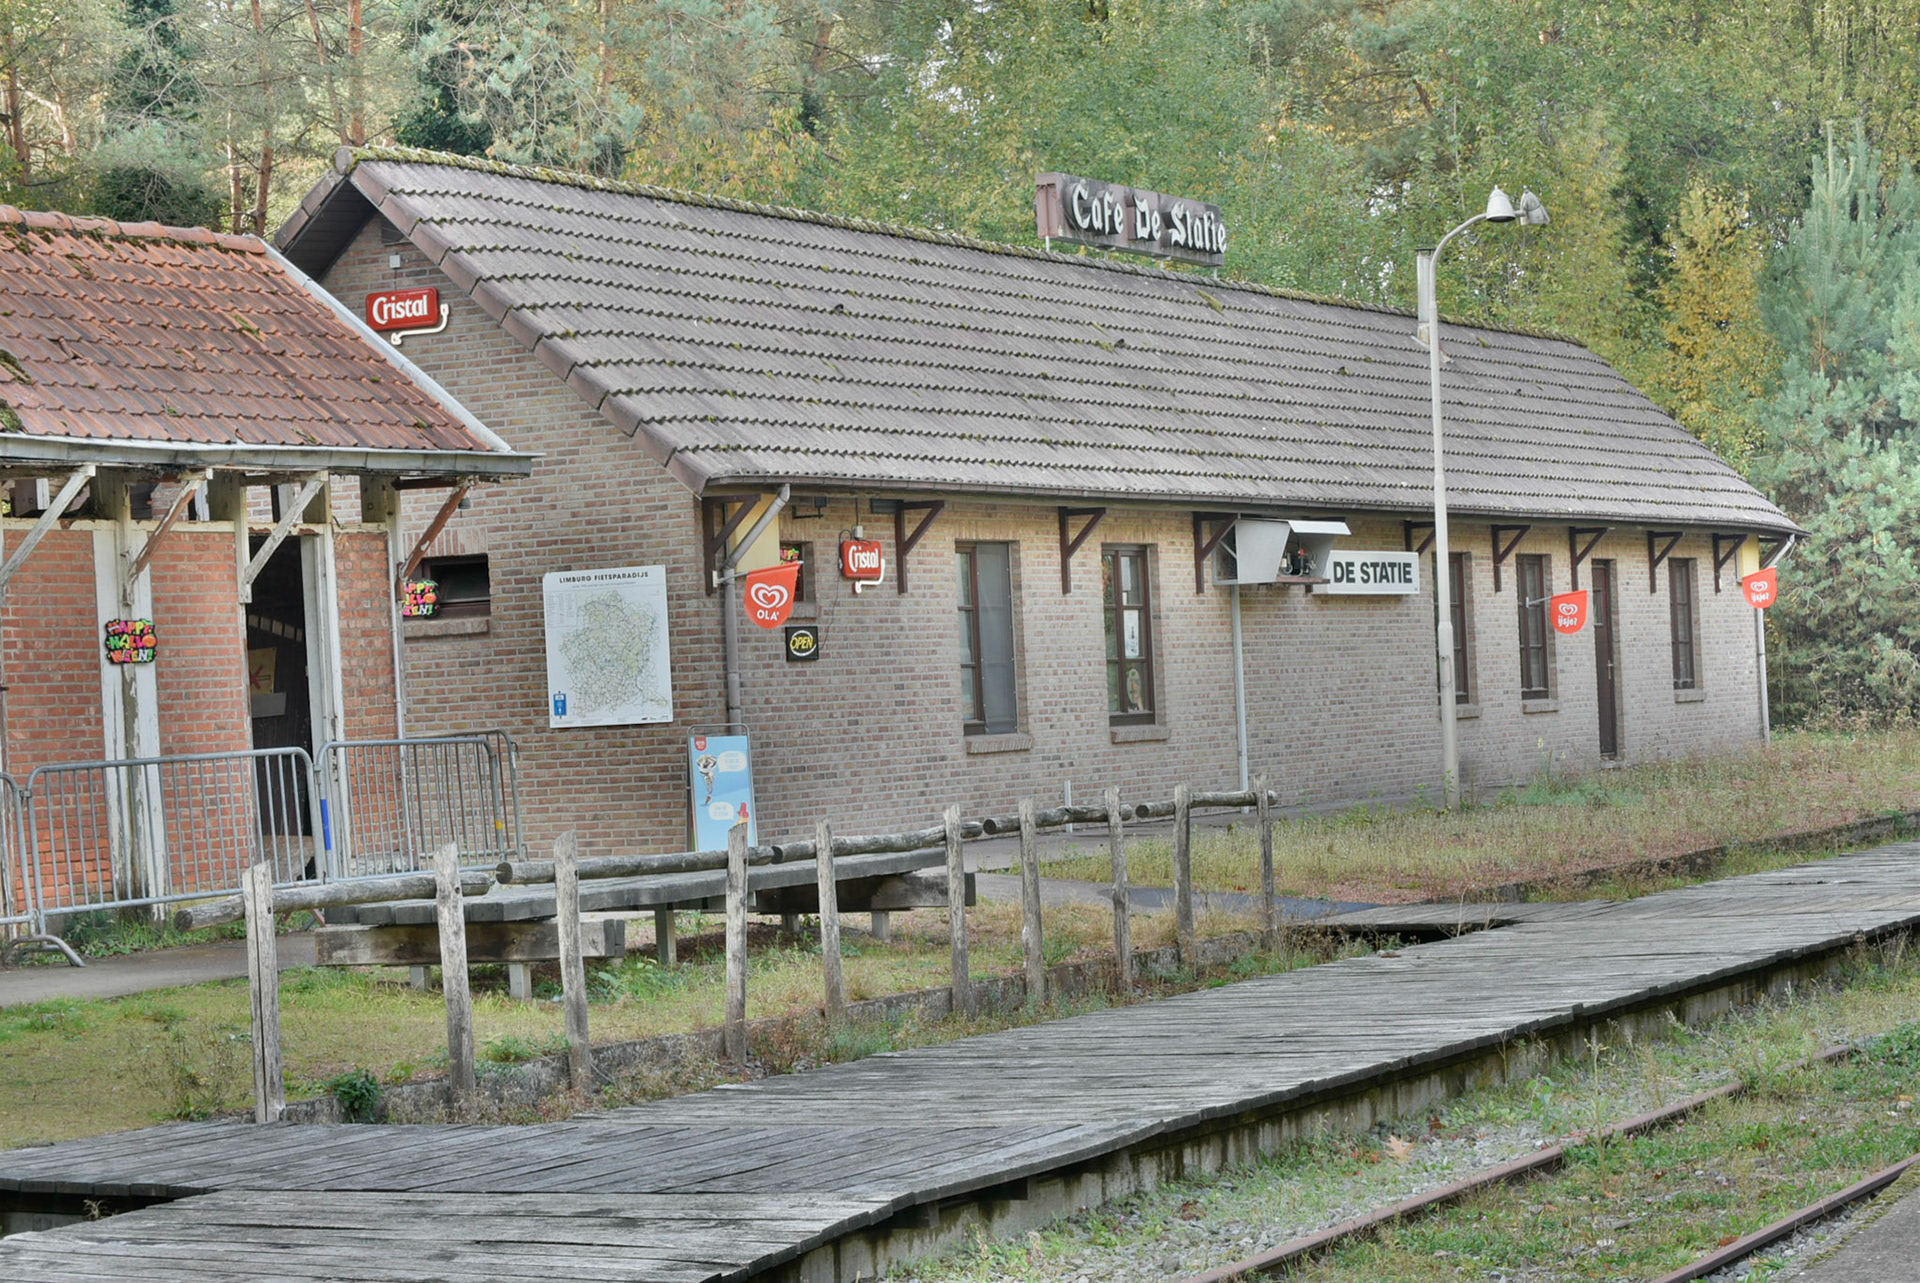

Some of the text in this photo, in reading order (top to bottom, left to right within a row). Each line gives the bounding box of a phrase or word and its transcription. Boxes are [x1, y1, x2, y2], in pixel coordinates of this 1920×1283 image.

[1134, 194, 1162, 241] De
[1168, 201, 1227, 254] Statie
[372, 294, 429, 325] Cristal
[848, 545, 880, 573] Cristal
[559, 571, 649, 584] LIMBURG FIETSPARADIJS
[1333, 561, 1413, 584] DE STATIE
[403, 604, 434, 616] EEN!
[756, 609, 778, 621] OLA
[790, 636, 814, 649] OPEN
